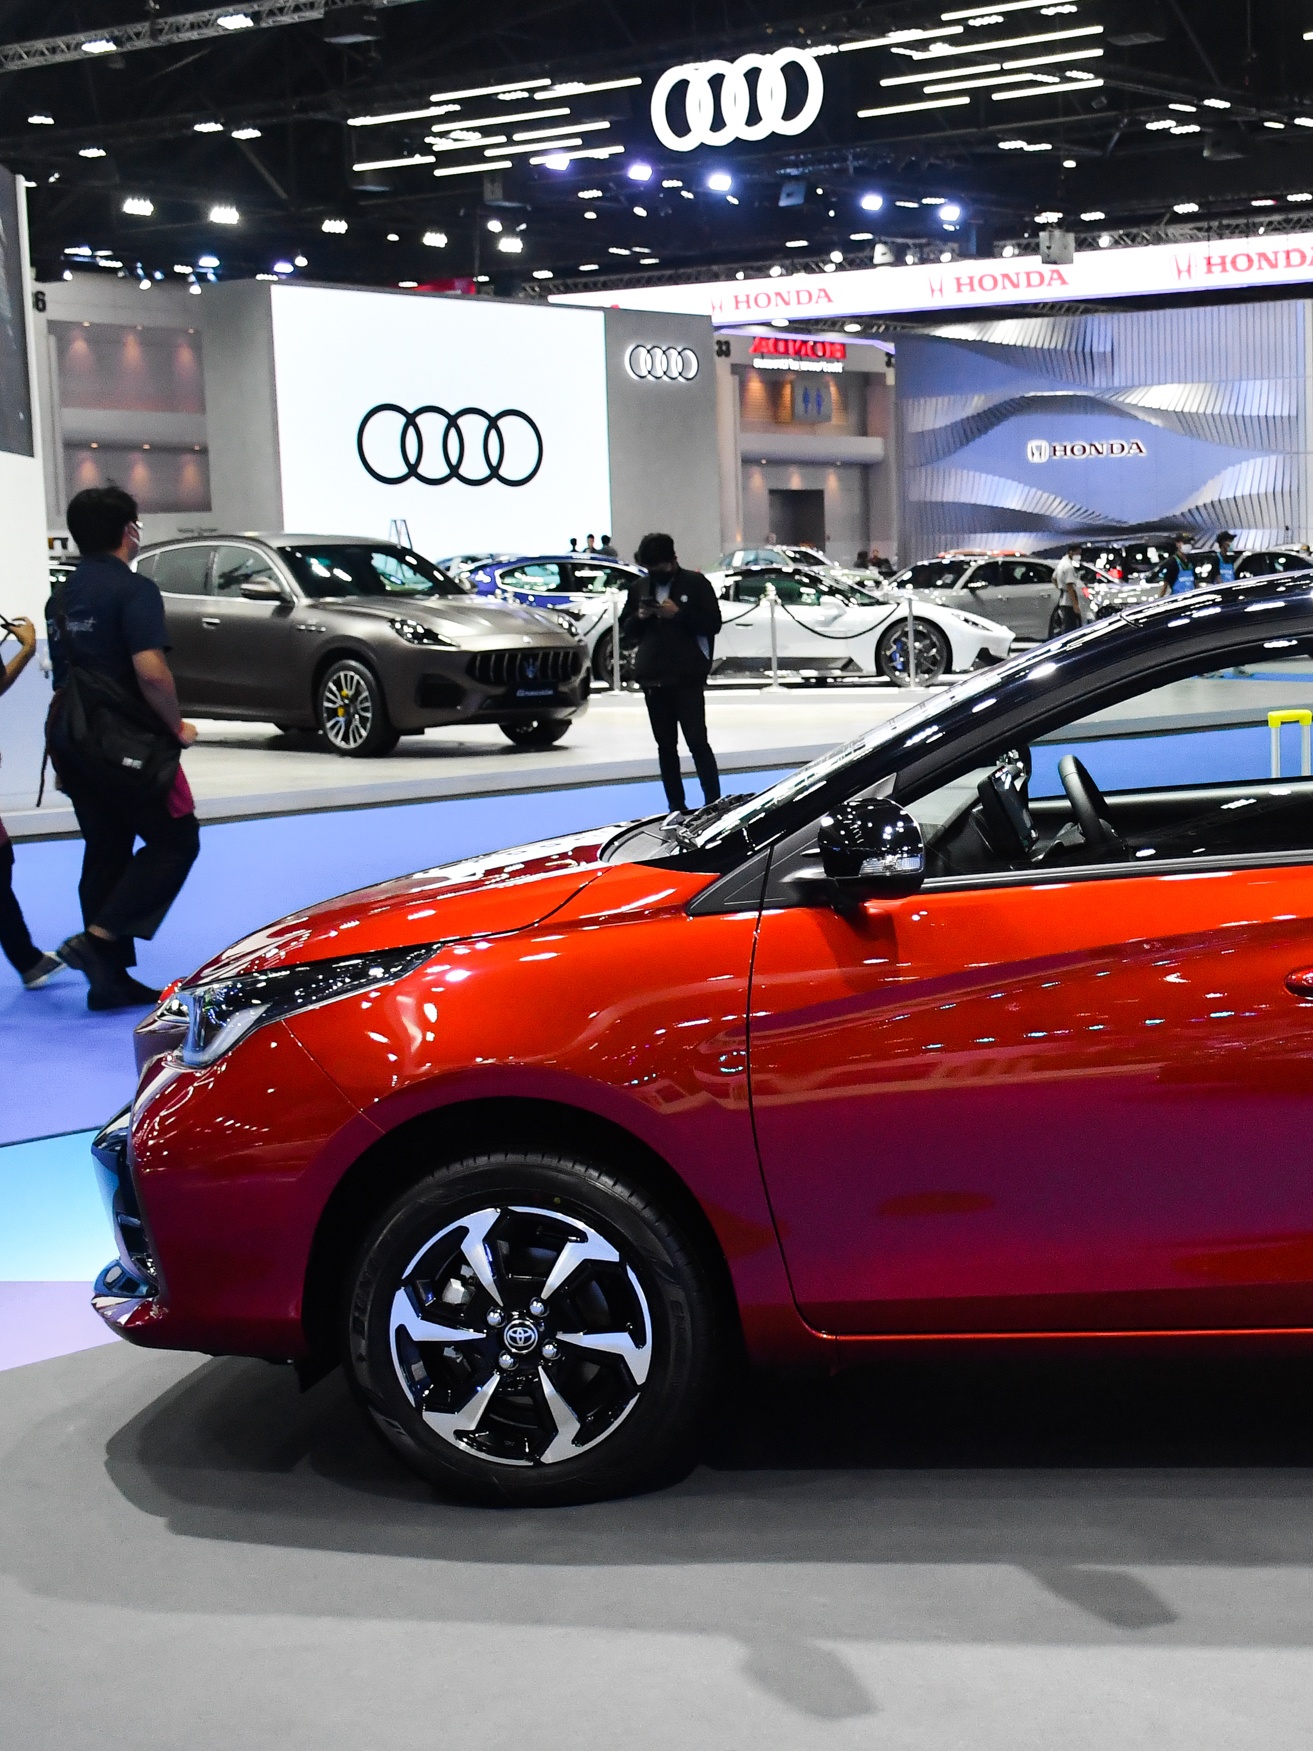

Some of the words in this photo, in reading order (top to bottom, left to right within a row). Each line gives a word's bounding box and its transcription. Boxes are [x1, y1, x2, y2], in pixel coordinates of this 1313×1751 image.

[954, 268, 1069, 294] HONDA
[733, 287, 833, 311] HONDA
[1051, 440, 1146, 458] HONDA
